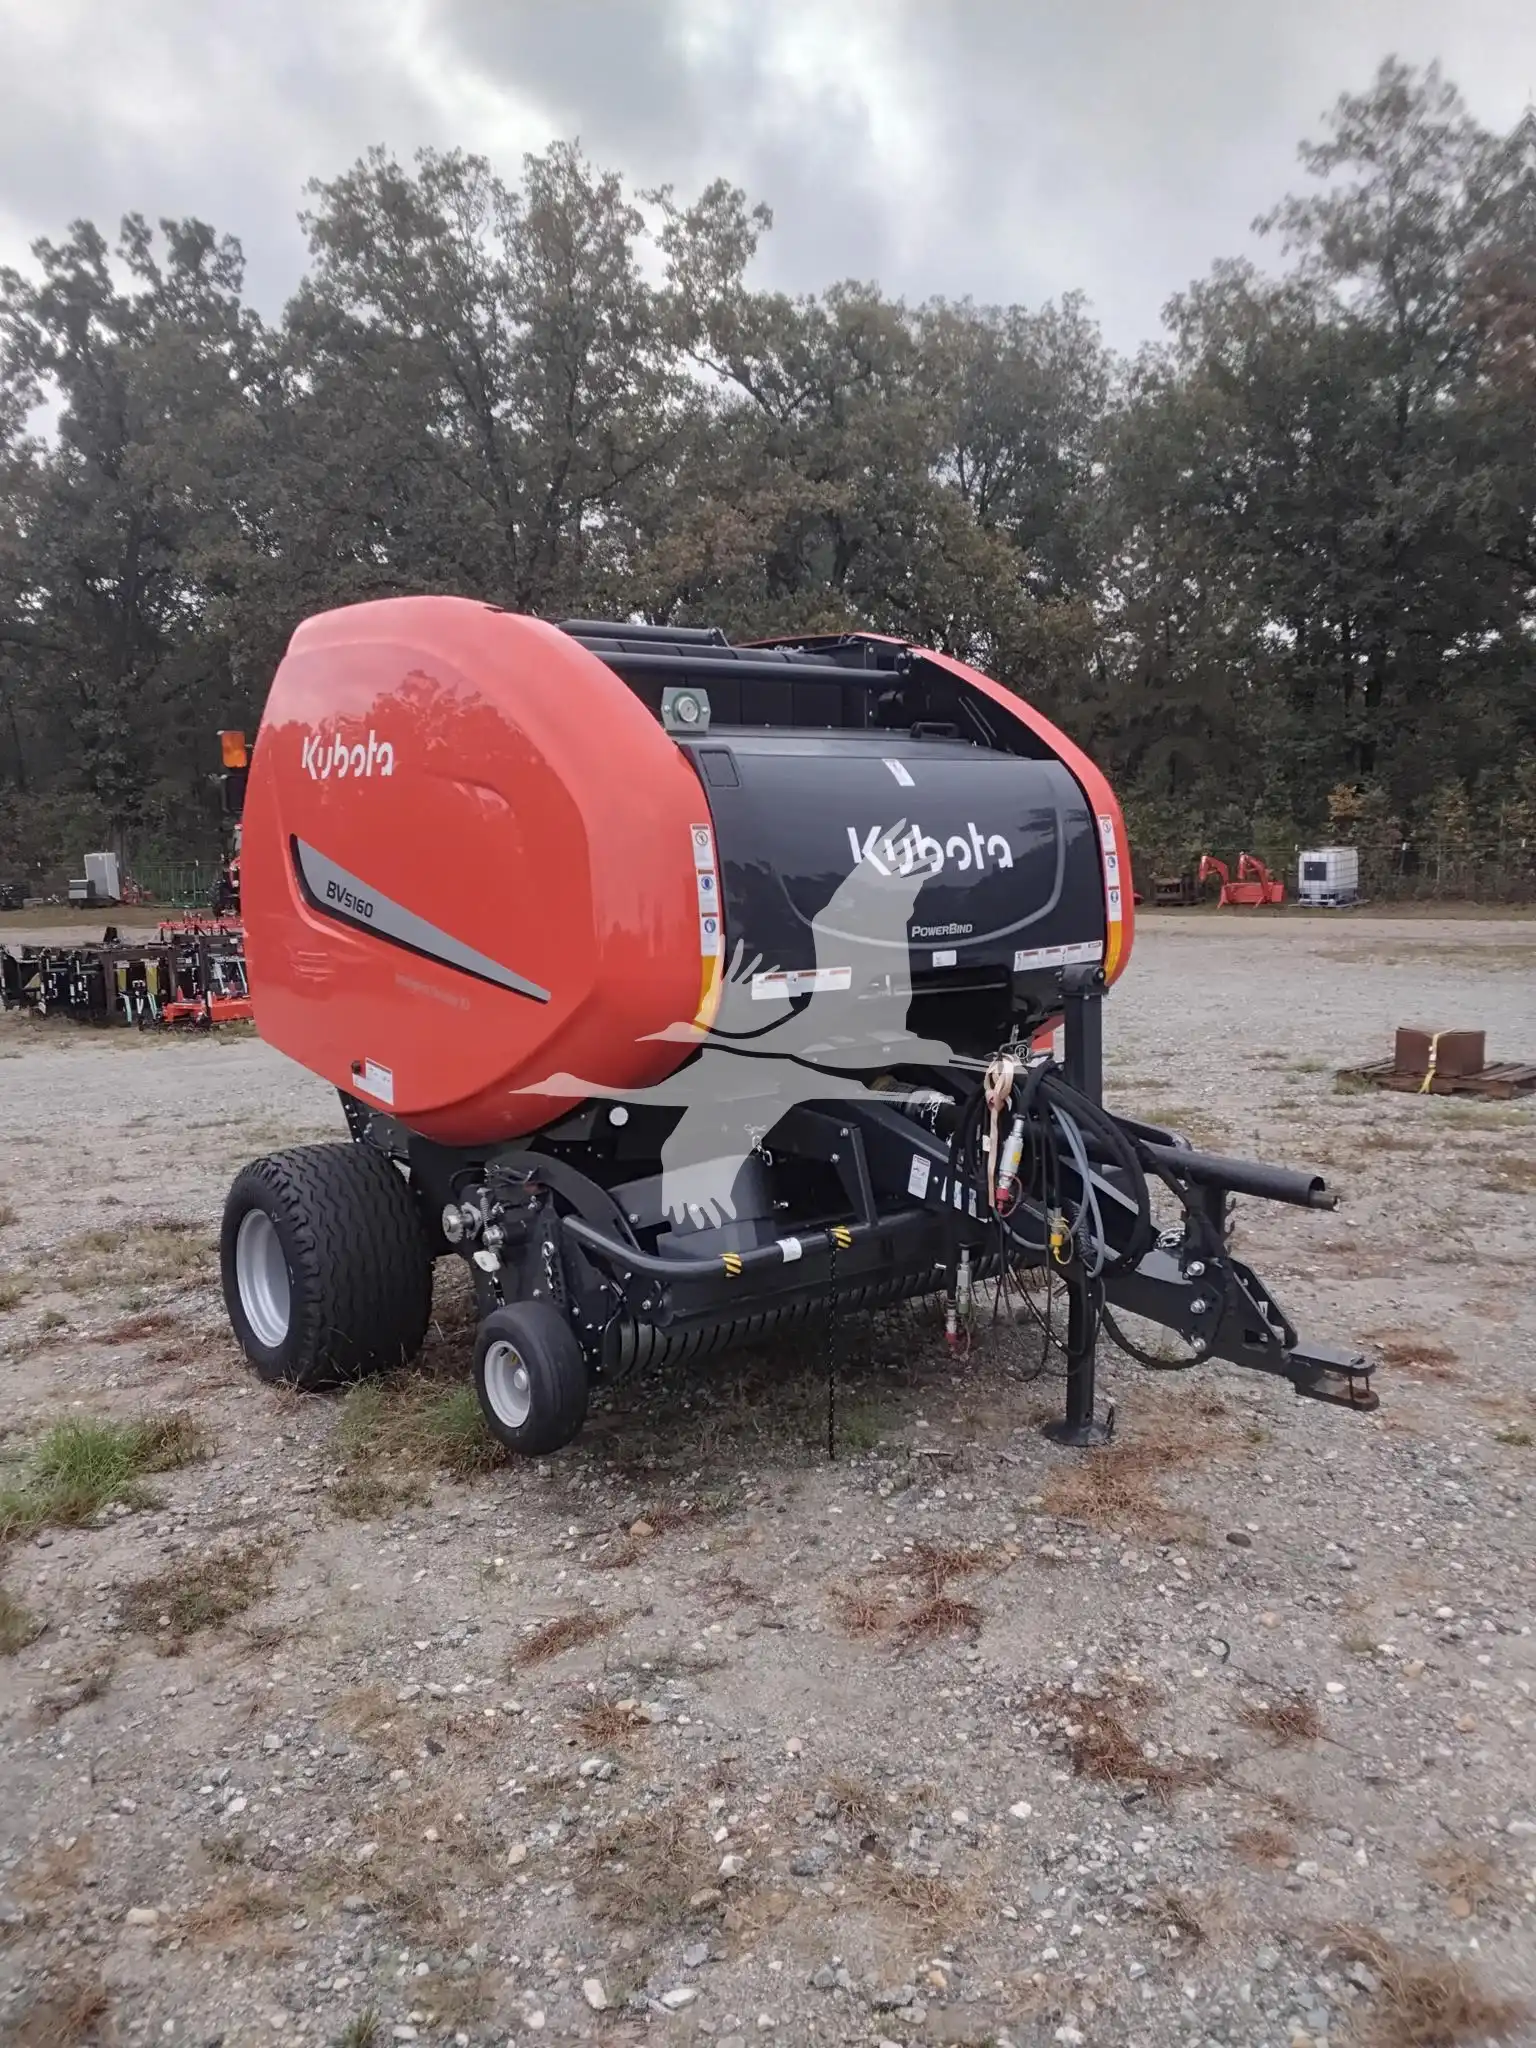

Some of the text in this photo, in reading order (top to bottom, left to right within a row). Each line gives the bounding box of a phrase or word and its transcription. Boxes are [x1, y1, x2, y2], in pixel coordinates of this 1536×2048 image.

[301, 729, 394, 780] Kubota
[846, 821, 1014, 876] Kubota
[326, 879, 374, 919] BV5160
